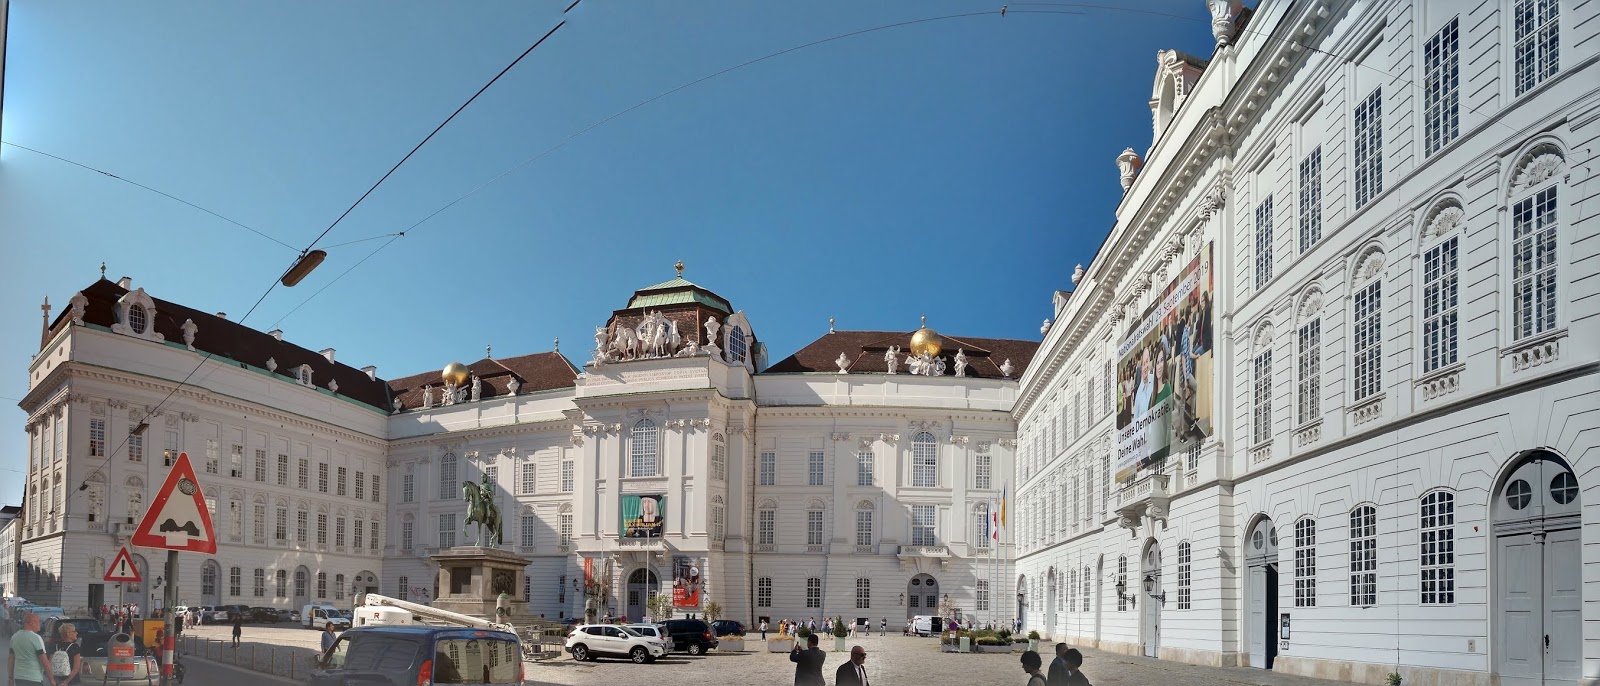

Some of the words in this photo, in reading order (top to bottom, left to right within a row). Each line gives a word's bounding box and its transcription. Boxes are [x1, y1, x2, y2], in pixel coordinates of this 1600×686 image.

[1163, 279, 1193, 314] September
[1193, 260, 1209, 285] 2019
[1117, 426, 1135, 445] Unsere
[1135, 402, 1171, 433] Demokratie.
[1117, 445, 1132, 461] Deine
[1132, 432, 1148, 452] Wahl.
